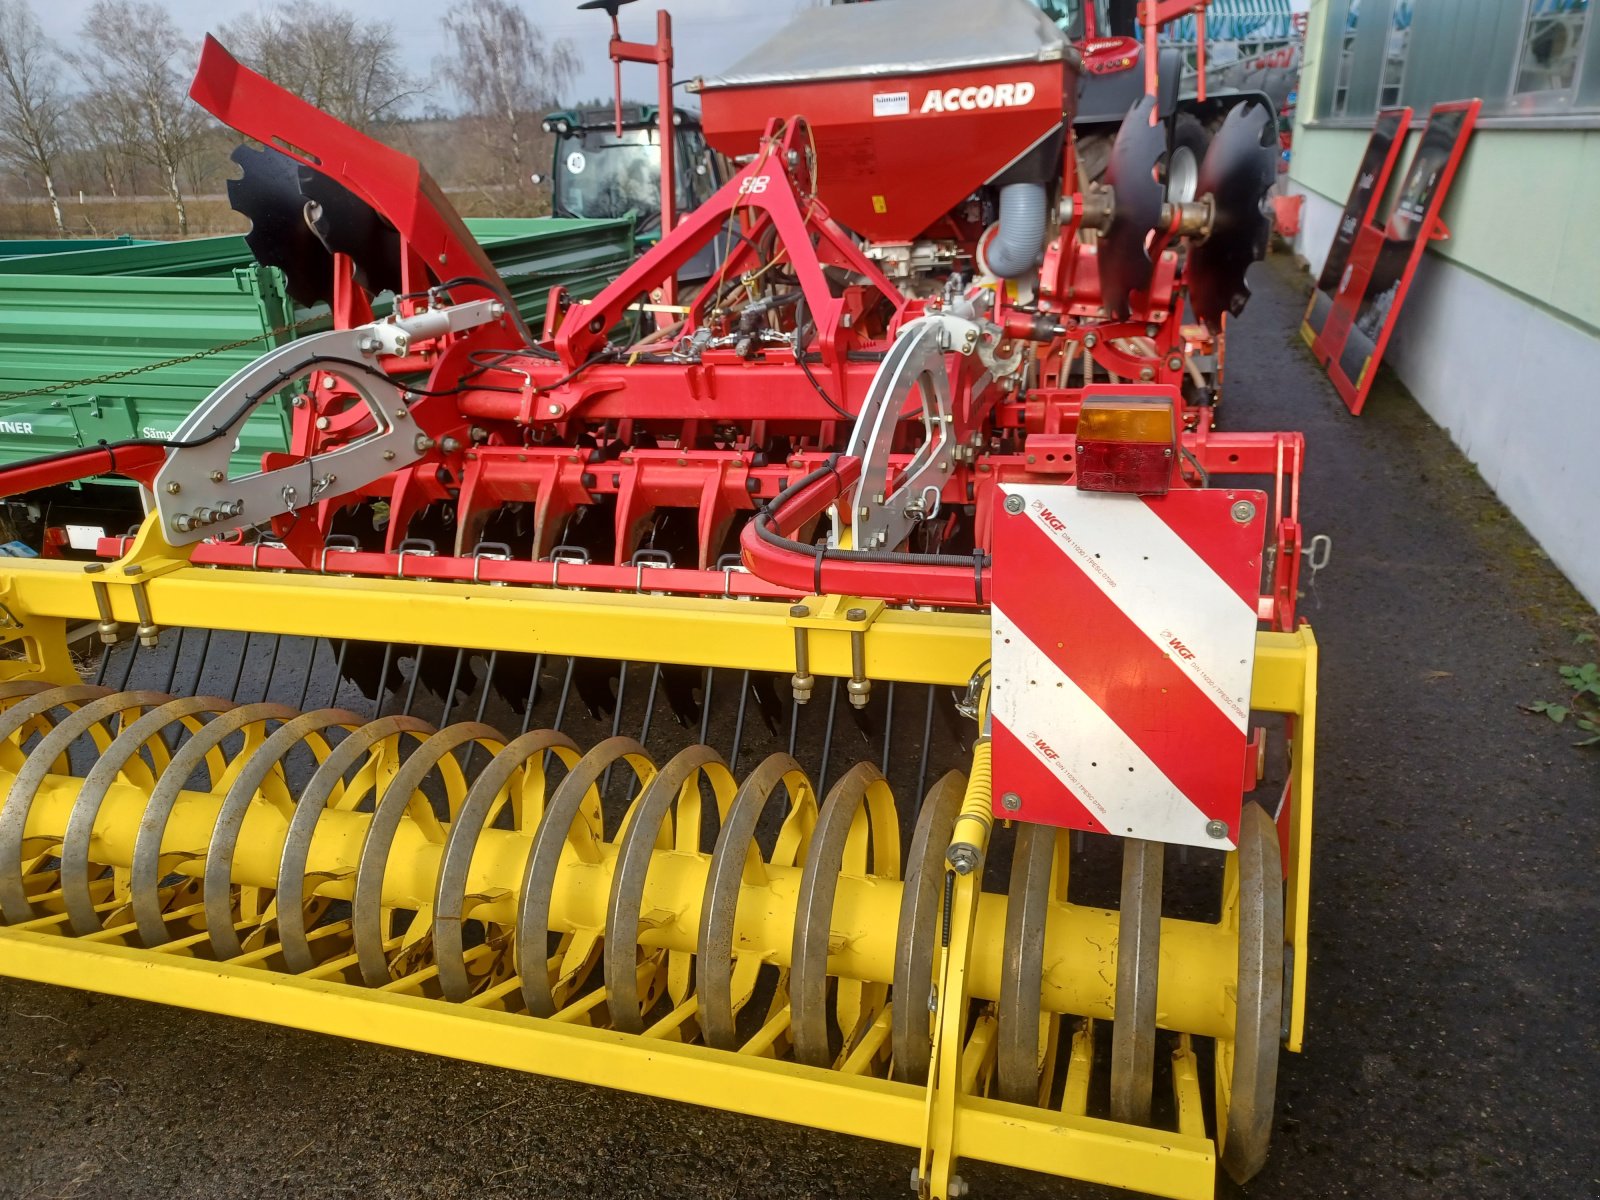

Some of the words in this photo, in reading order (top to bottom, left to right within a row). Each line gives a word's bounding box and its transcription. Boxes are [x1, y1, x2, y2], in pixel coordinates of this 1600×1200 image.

[920, 82, 1035, 113] ACCORD
[1040, 508, 1066, 531] WGF
[1168, 637, 1196, 660] WGF
[1034, 738, 1060, 760] WGF
